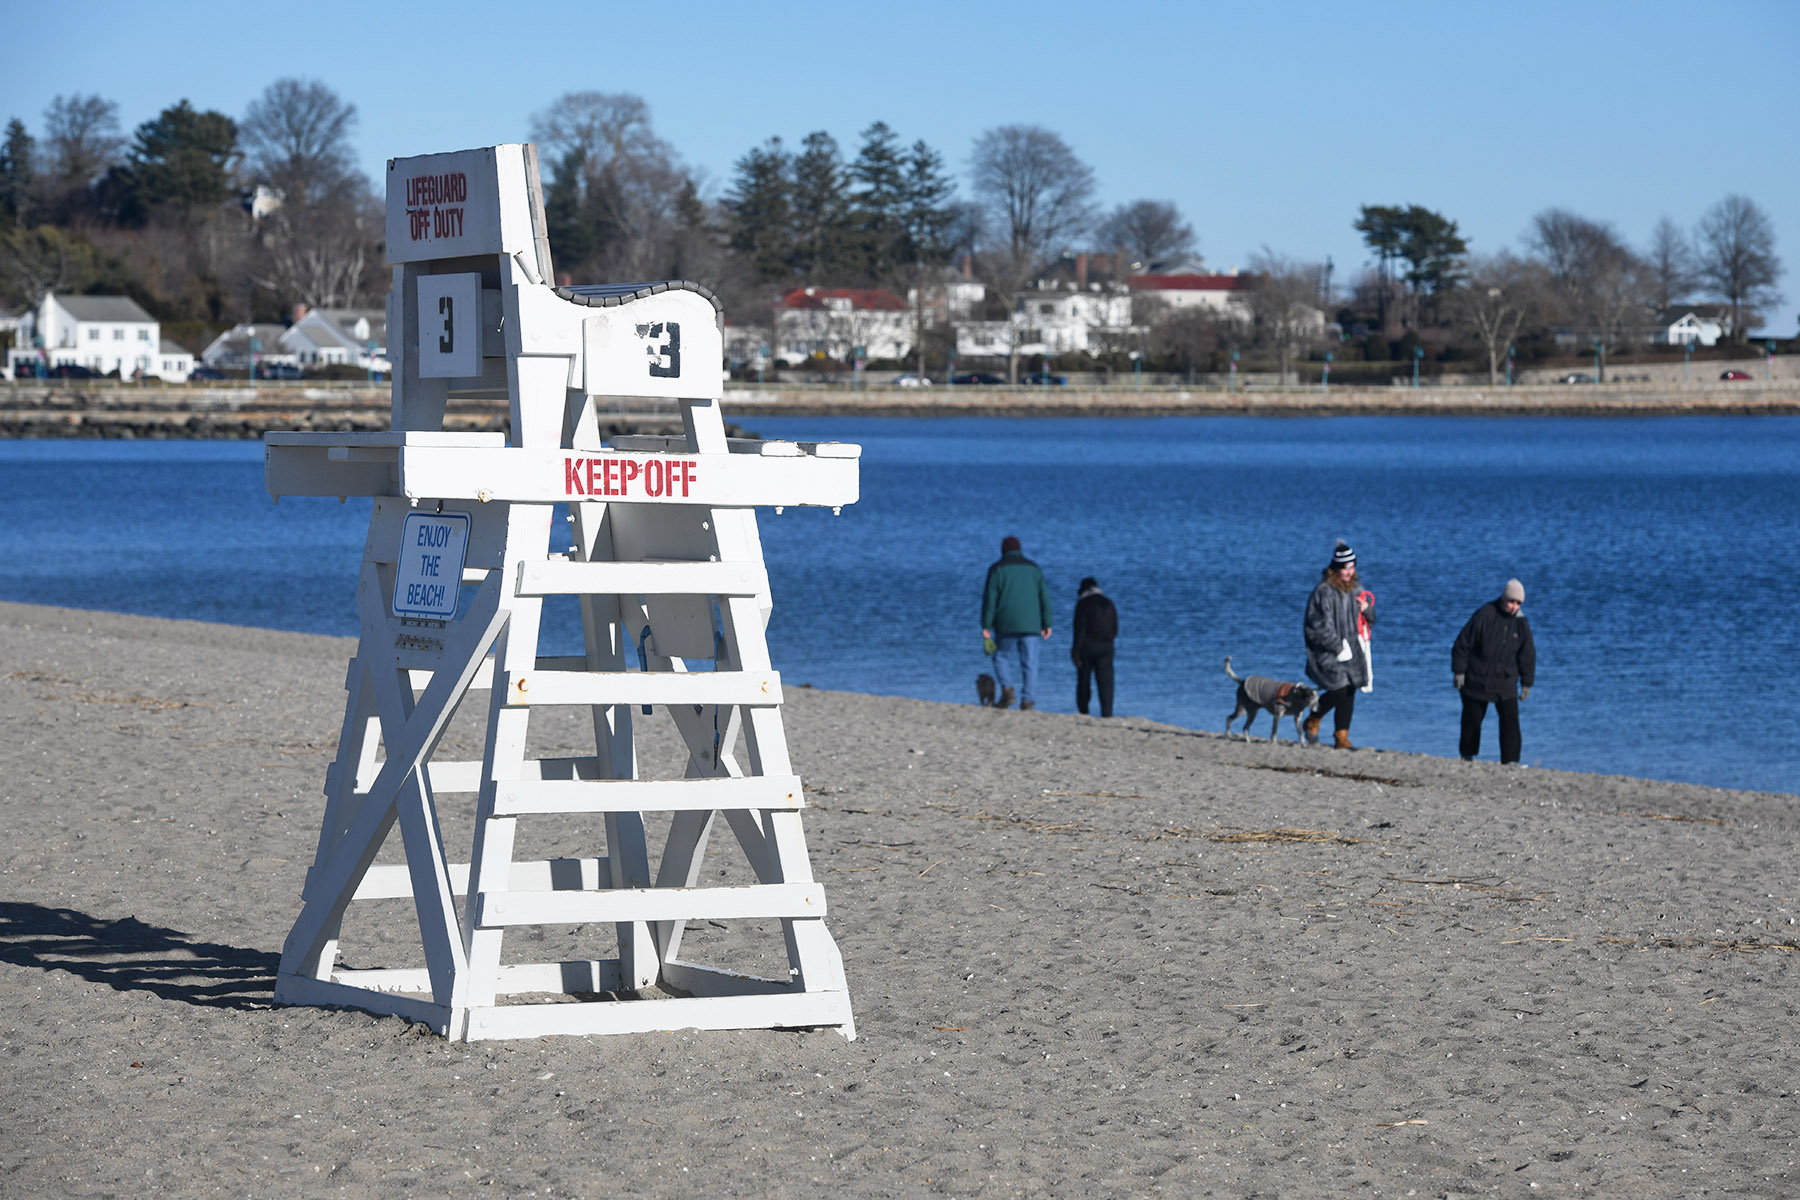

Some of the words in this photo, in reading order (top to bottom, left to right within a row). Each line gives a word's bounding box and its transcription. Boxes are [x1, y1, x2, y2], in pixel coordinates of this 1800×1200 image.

[406, 172, 467, 206] LIFEGUARD
[410, 209, 430, 241] OFF
[434, 208, 464, 239] DUTY
[439, 296, 454, 353] 3
[648, 321, 681, 378] 3
[564, 457, 639, 496] KEEP
[644, 459, 697, 497] OFF
[417, 525, 453, 548] ENJOY
[420, 554, 441, 577] THE
[407, 583, 446, 607] BEACH!
